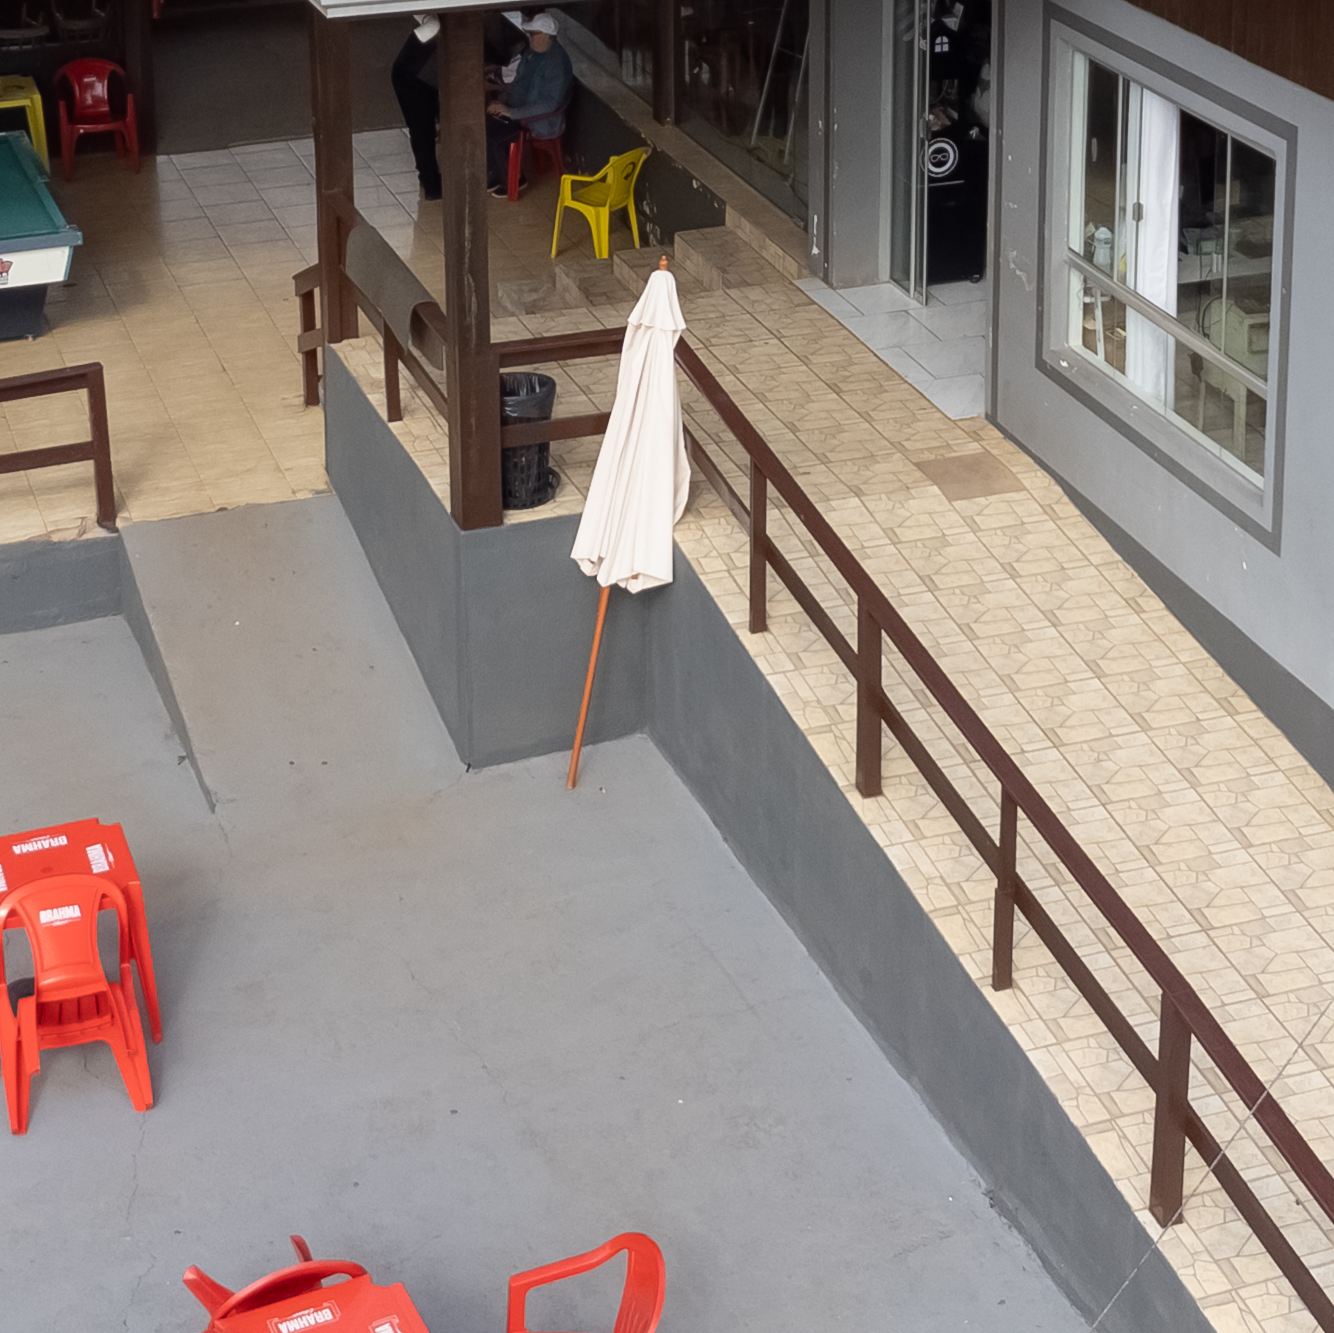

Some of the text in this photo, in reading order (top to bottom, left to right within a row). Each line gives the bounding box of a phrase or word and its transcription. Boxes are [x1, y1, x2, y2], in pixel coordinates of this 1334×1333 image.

[12, 835, 68, 854] BRAHMA
[39, 904, 82, 924] BRAHMA
[277, 1308, 333, 1333] BRAHMA
